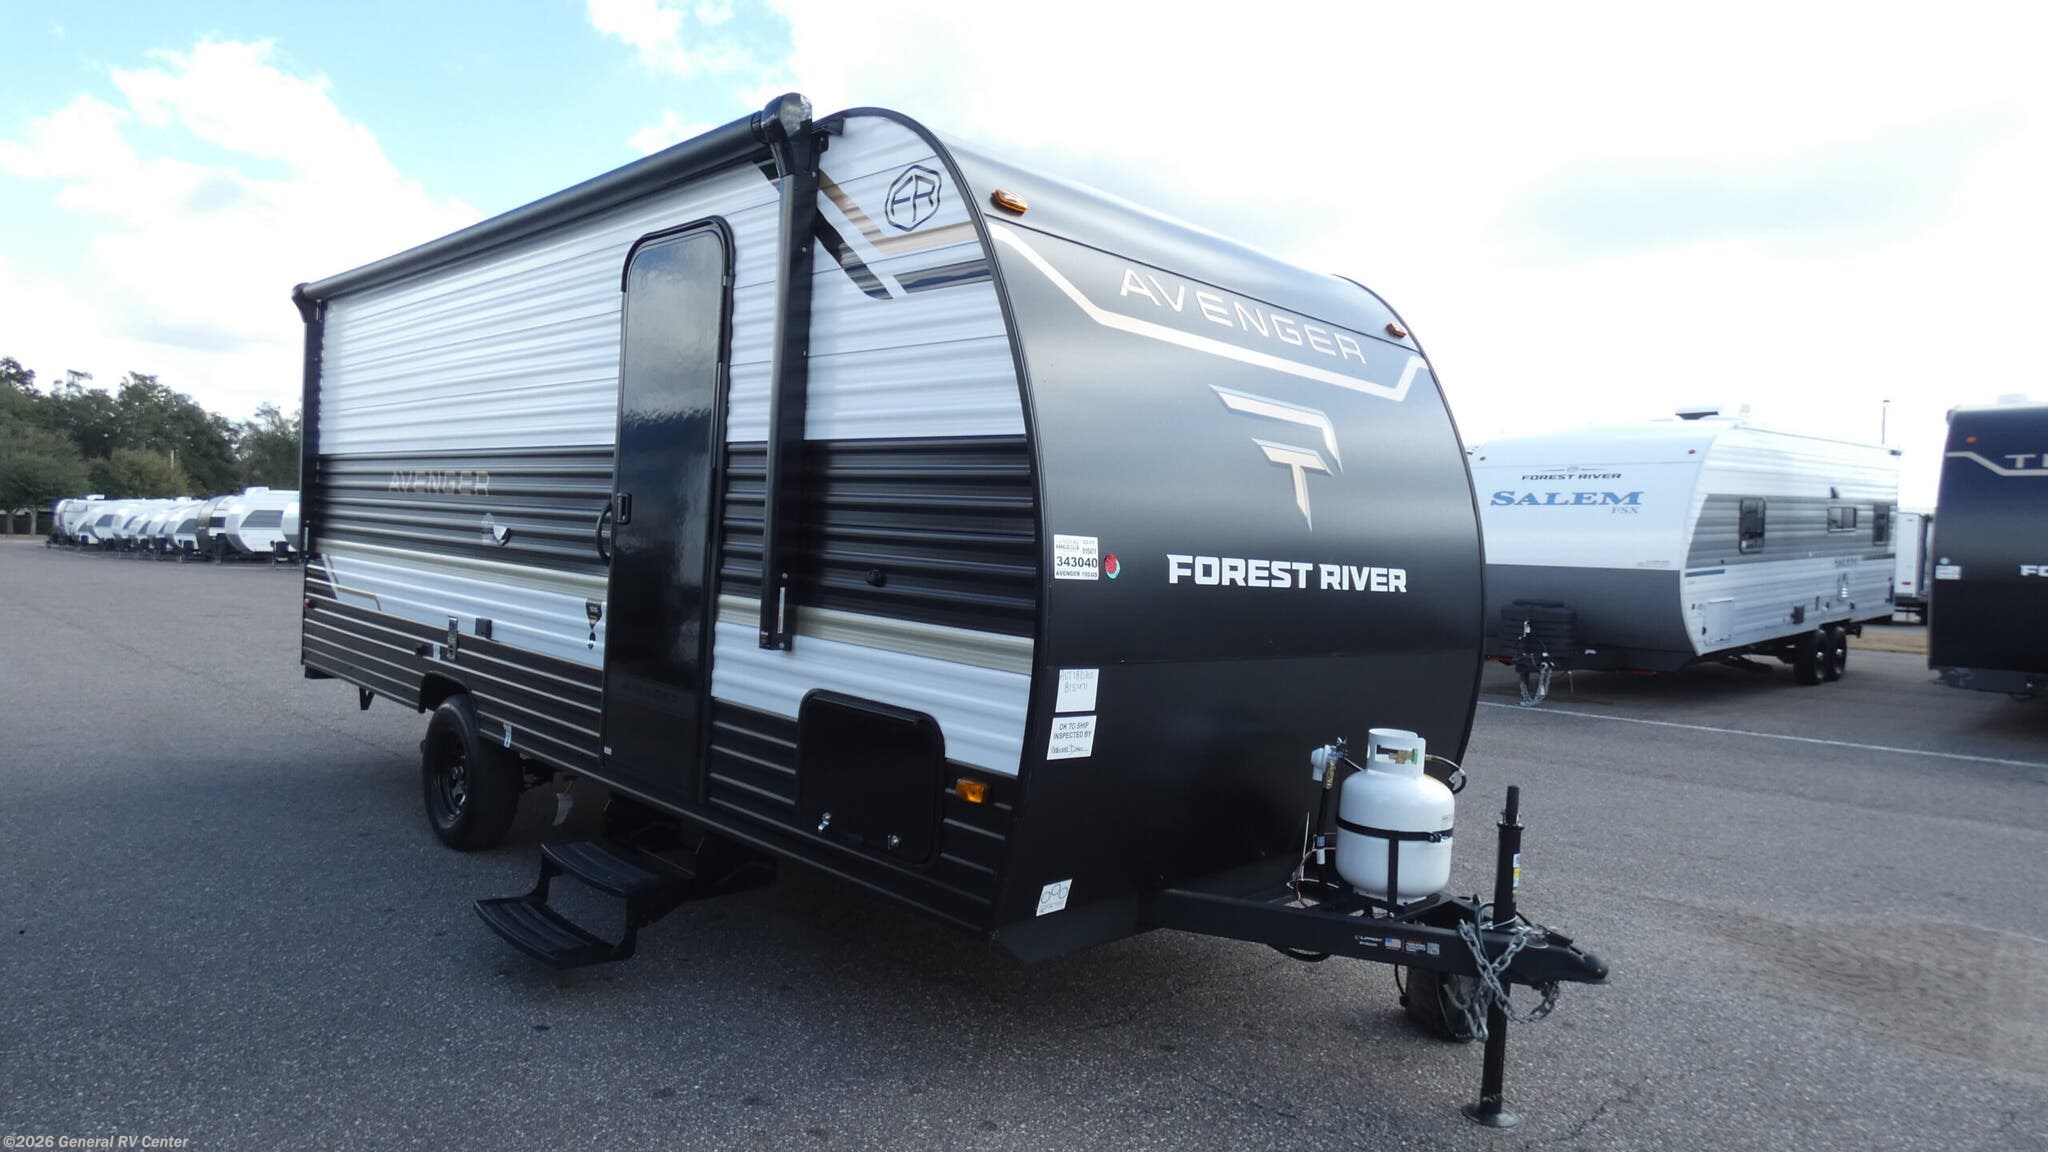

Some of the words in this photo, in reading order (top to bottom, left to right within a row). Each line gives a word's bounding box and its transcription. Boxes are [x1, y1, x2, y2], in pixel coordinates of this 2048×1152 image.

[1120, 268, 1366, 365] AVENGER
[389, 471, 490, 496] AVENGER
[1490, 490, 1645, 506] SALEM
[1056, 555, 1098, 569] 343040
[1166, 554, 1313, 589] FOREST
[1318, 563, 1407, 593] RIVER
[1053, 731, 1084, 740] INSPECTED
